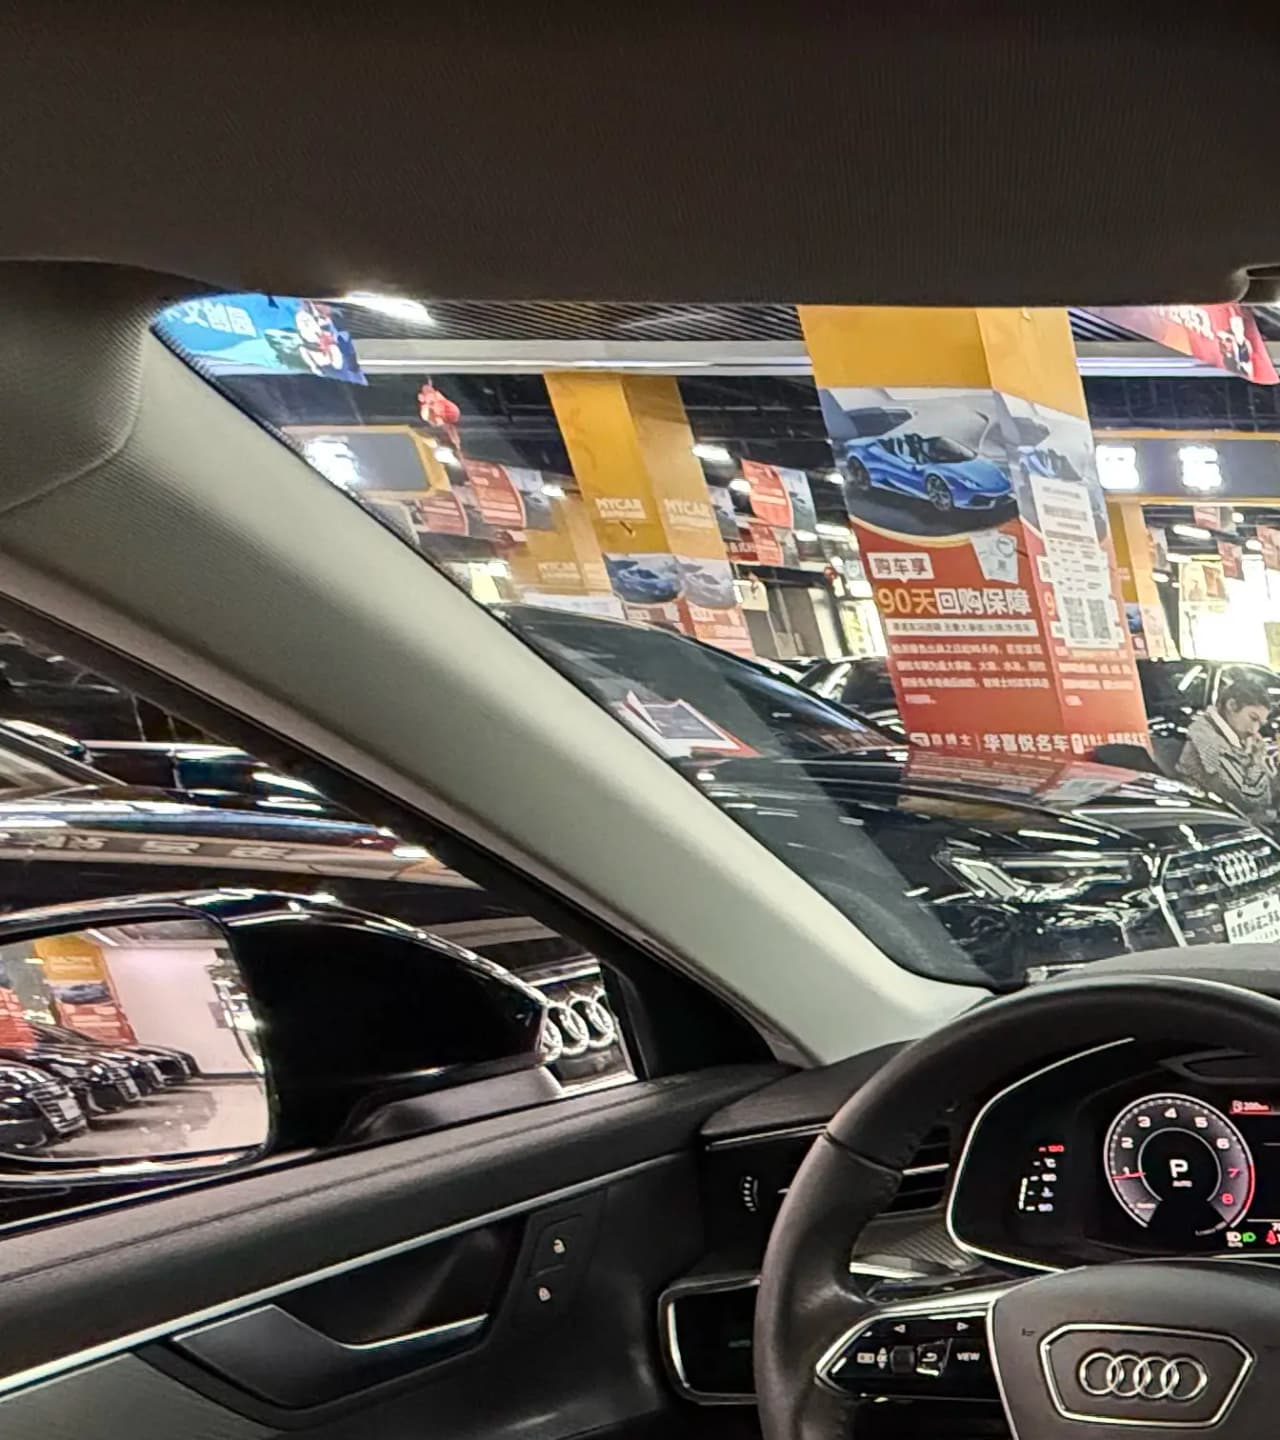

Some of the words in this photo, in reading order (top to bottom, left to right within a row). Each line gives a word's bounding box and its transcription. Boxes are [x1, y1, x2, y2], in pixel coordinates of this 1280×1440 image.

[874, 557, 928, 576] 购车享
[878, 587, 1033, 616] 90天回购保障
[1164, 1107, 1178, 1118] 4
[1138, 1115, 1151, 1128] 3
[1194, 1116, 1208, 1128] 5
[1121, 1137, 1134, 1149] 2
[1216, 1138, 1230, 1149] 6
[1169, 1158, 1189, 1178] P
[1227, 1168, 1240, 1178] 7
[956, 1352, 980, 1362] VIEW
